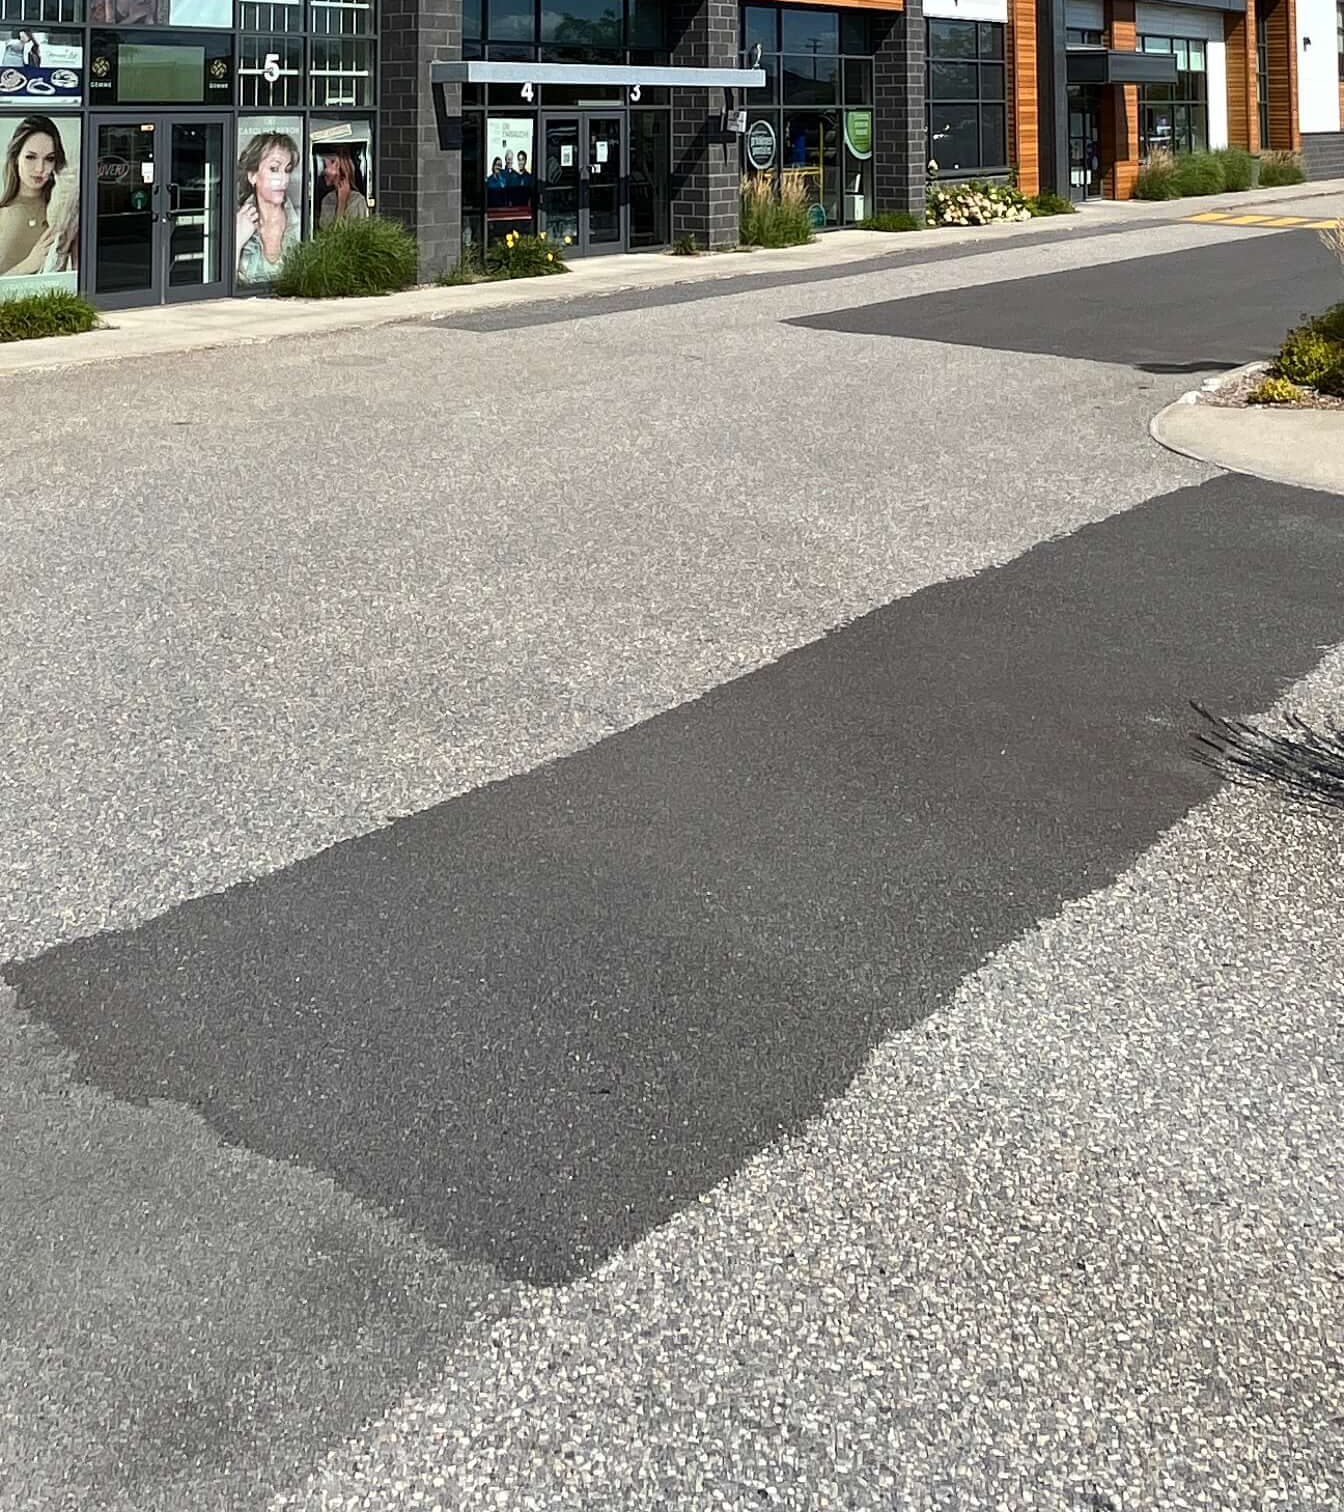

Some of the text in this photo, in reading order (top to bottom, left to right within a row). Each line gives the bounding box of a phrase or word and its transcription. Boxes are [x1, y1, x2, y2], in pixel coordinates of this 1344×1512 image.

[264, 54, 280, 82] 5
[521, 82, 534, 102] 4
[630, 84, 641, 102] 3
